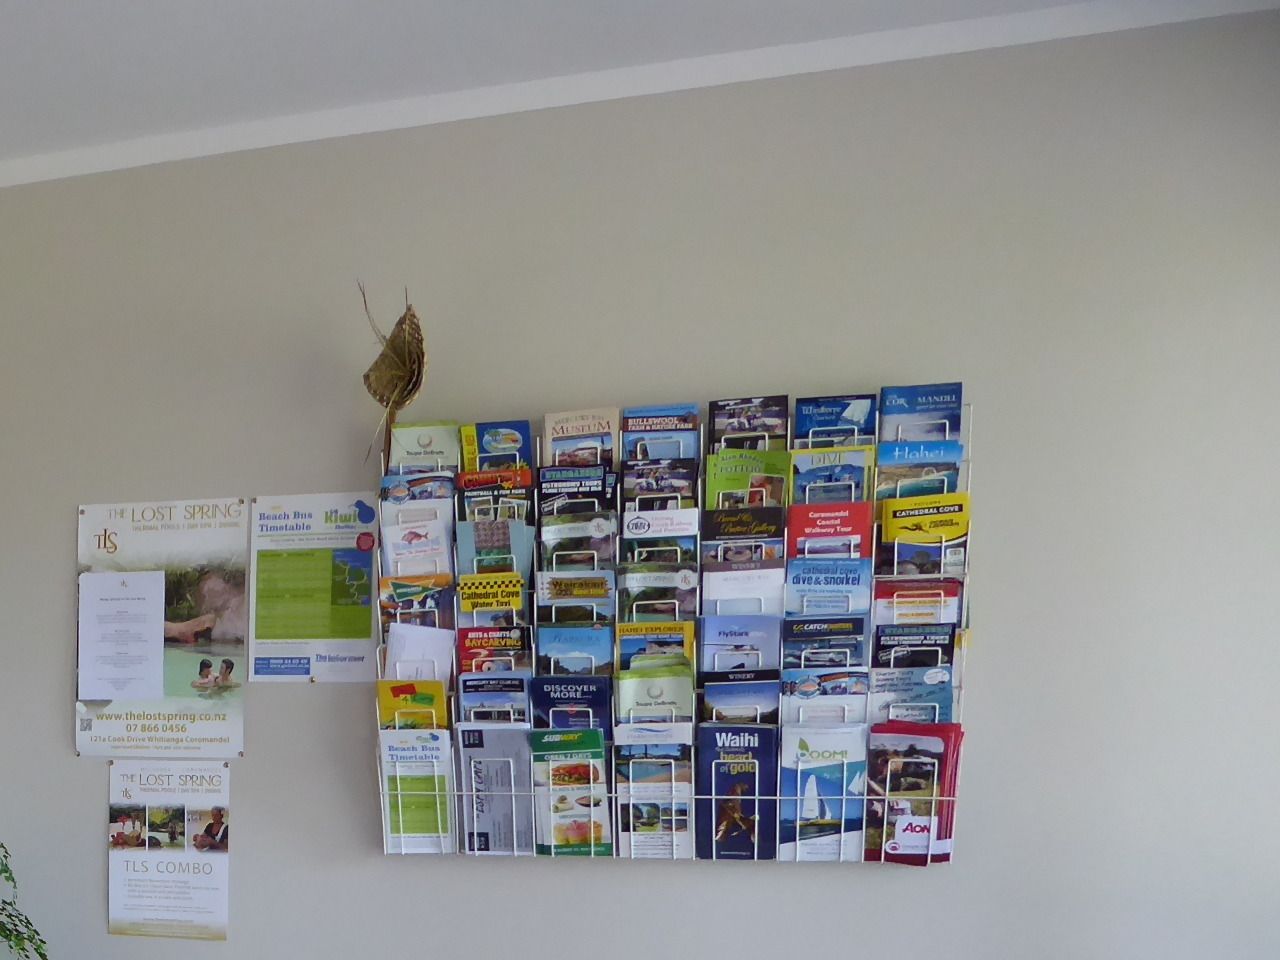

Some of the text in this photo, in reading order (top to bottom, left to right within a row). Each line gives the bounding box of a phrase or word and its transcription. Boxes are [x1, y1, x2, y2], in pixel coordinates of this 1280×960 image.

[628, 416, 679, 426] BULLSWOOL
[552, 420, 612, 437] MUSEUM
[893, 444, 945, 460] Hahei
[107, 502, 242, 522] THE LOST SPRING
[258, 510, 313, 521] Beach Bus
[808, 510, 849, 519] Coromandel
[896, 505, 959, 518] CATHEDRAL COVE
[816, 518, 841, 526] Coastal
[258, 522, 312, 533] Timetable
[836, 525, 853, 533] Tour
[802, 565, 858, 576] cathedral cove
[792, 573, 861, 586] dive & snorkel
[461, 589, 520, 601] Cathedral Cove
[470, 600, 511, 609] Water Taxi
[619, 626, 684, 635] HAHEI EXPLORER
[804, 623, 828, 631] CATCH
[468, 631, 483, 639] ARTS
[543, 684, 597, 692] DISCOVER
[550, 691, 583, 699] MORE
[95, 710, 227, 724] www.thelostspring.co.nz
[125, 723, 187, 733] 07 866 0456
[126, 735, 146, 743] Drive
[146, 735, 184, 744] Whitianga
[184, 735, 230, 744] Coromandel
[541, 733, 583, 743] SUBWAY
[715, 732, 759, 748] Waihi
[388, 753, 441, 762] Timetable
[571, 752, 592, 760] DAYS
[719, 751, 753, 761] heart
[719, 762, 757, 776] of gold
[121, 773, 222, 787] THE LOST SPRING
[902, 822, 931, 834] AON
[124, 859, 214, 876] TLS COMBO
